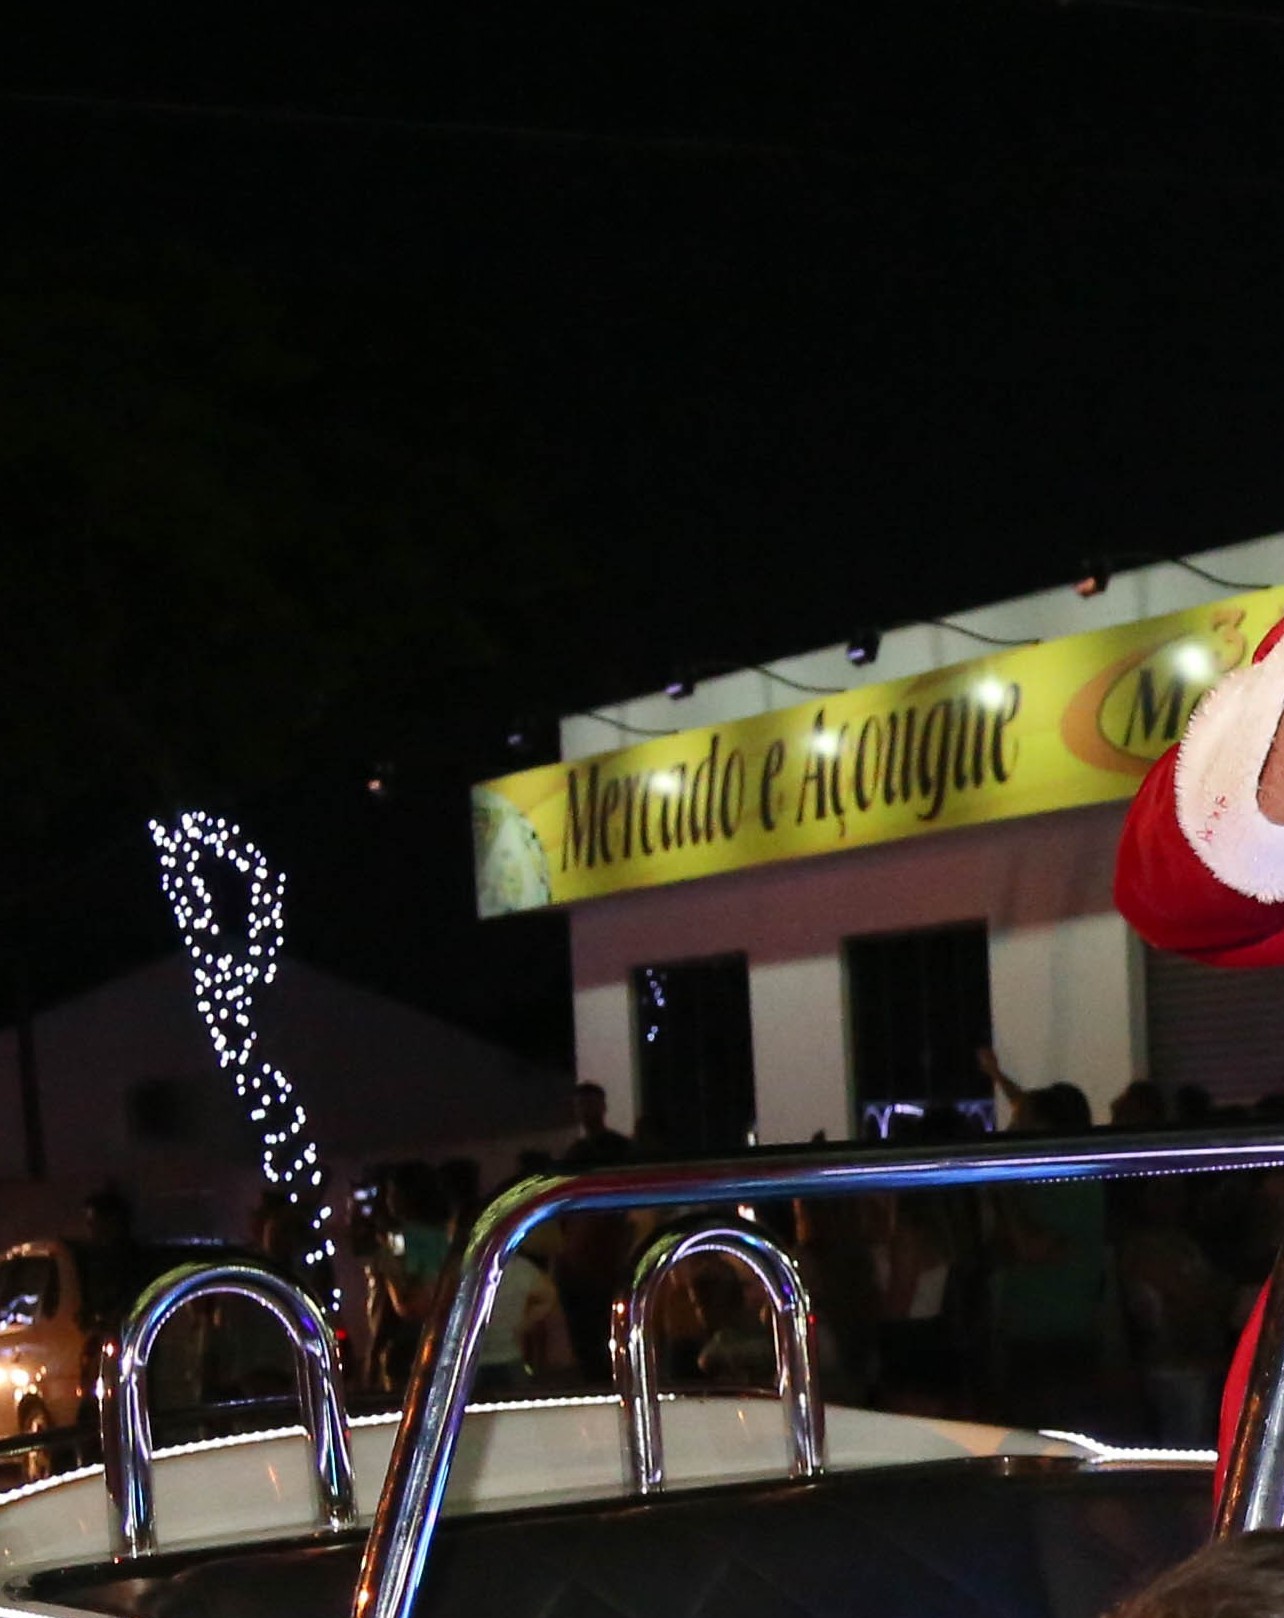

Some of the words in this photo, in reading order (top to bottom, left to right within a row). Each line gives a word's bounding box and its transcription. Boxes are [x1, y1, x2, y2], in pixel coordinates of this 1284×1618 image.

[562, 732, 745, 873] Mercado
[760, 739, 786, 832] e
[797, 682, 1021, 838] Açougue
